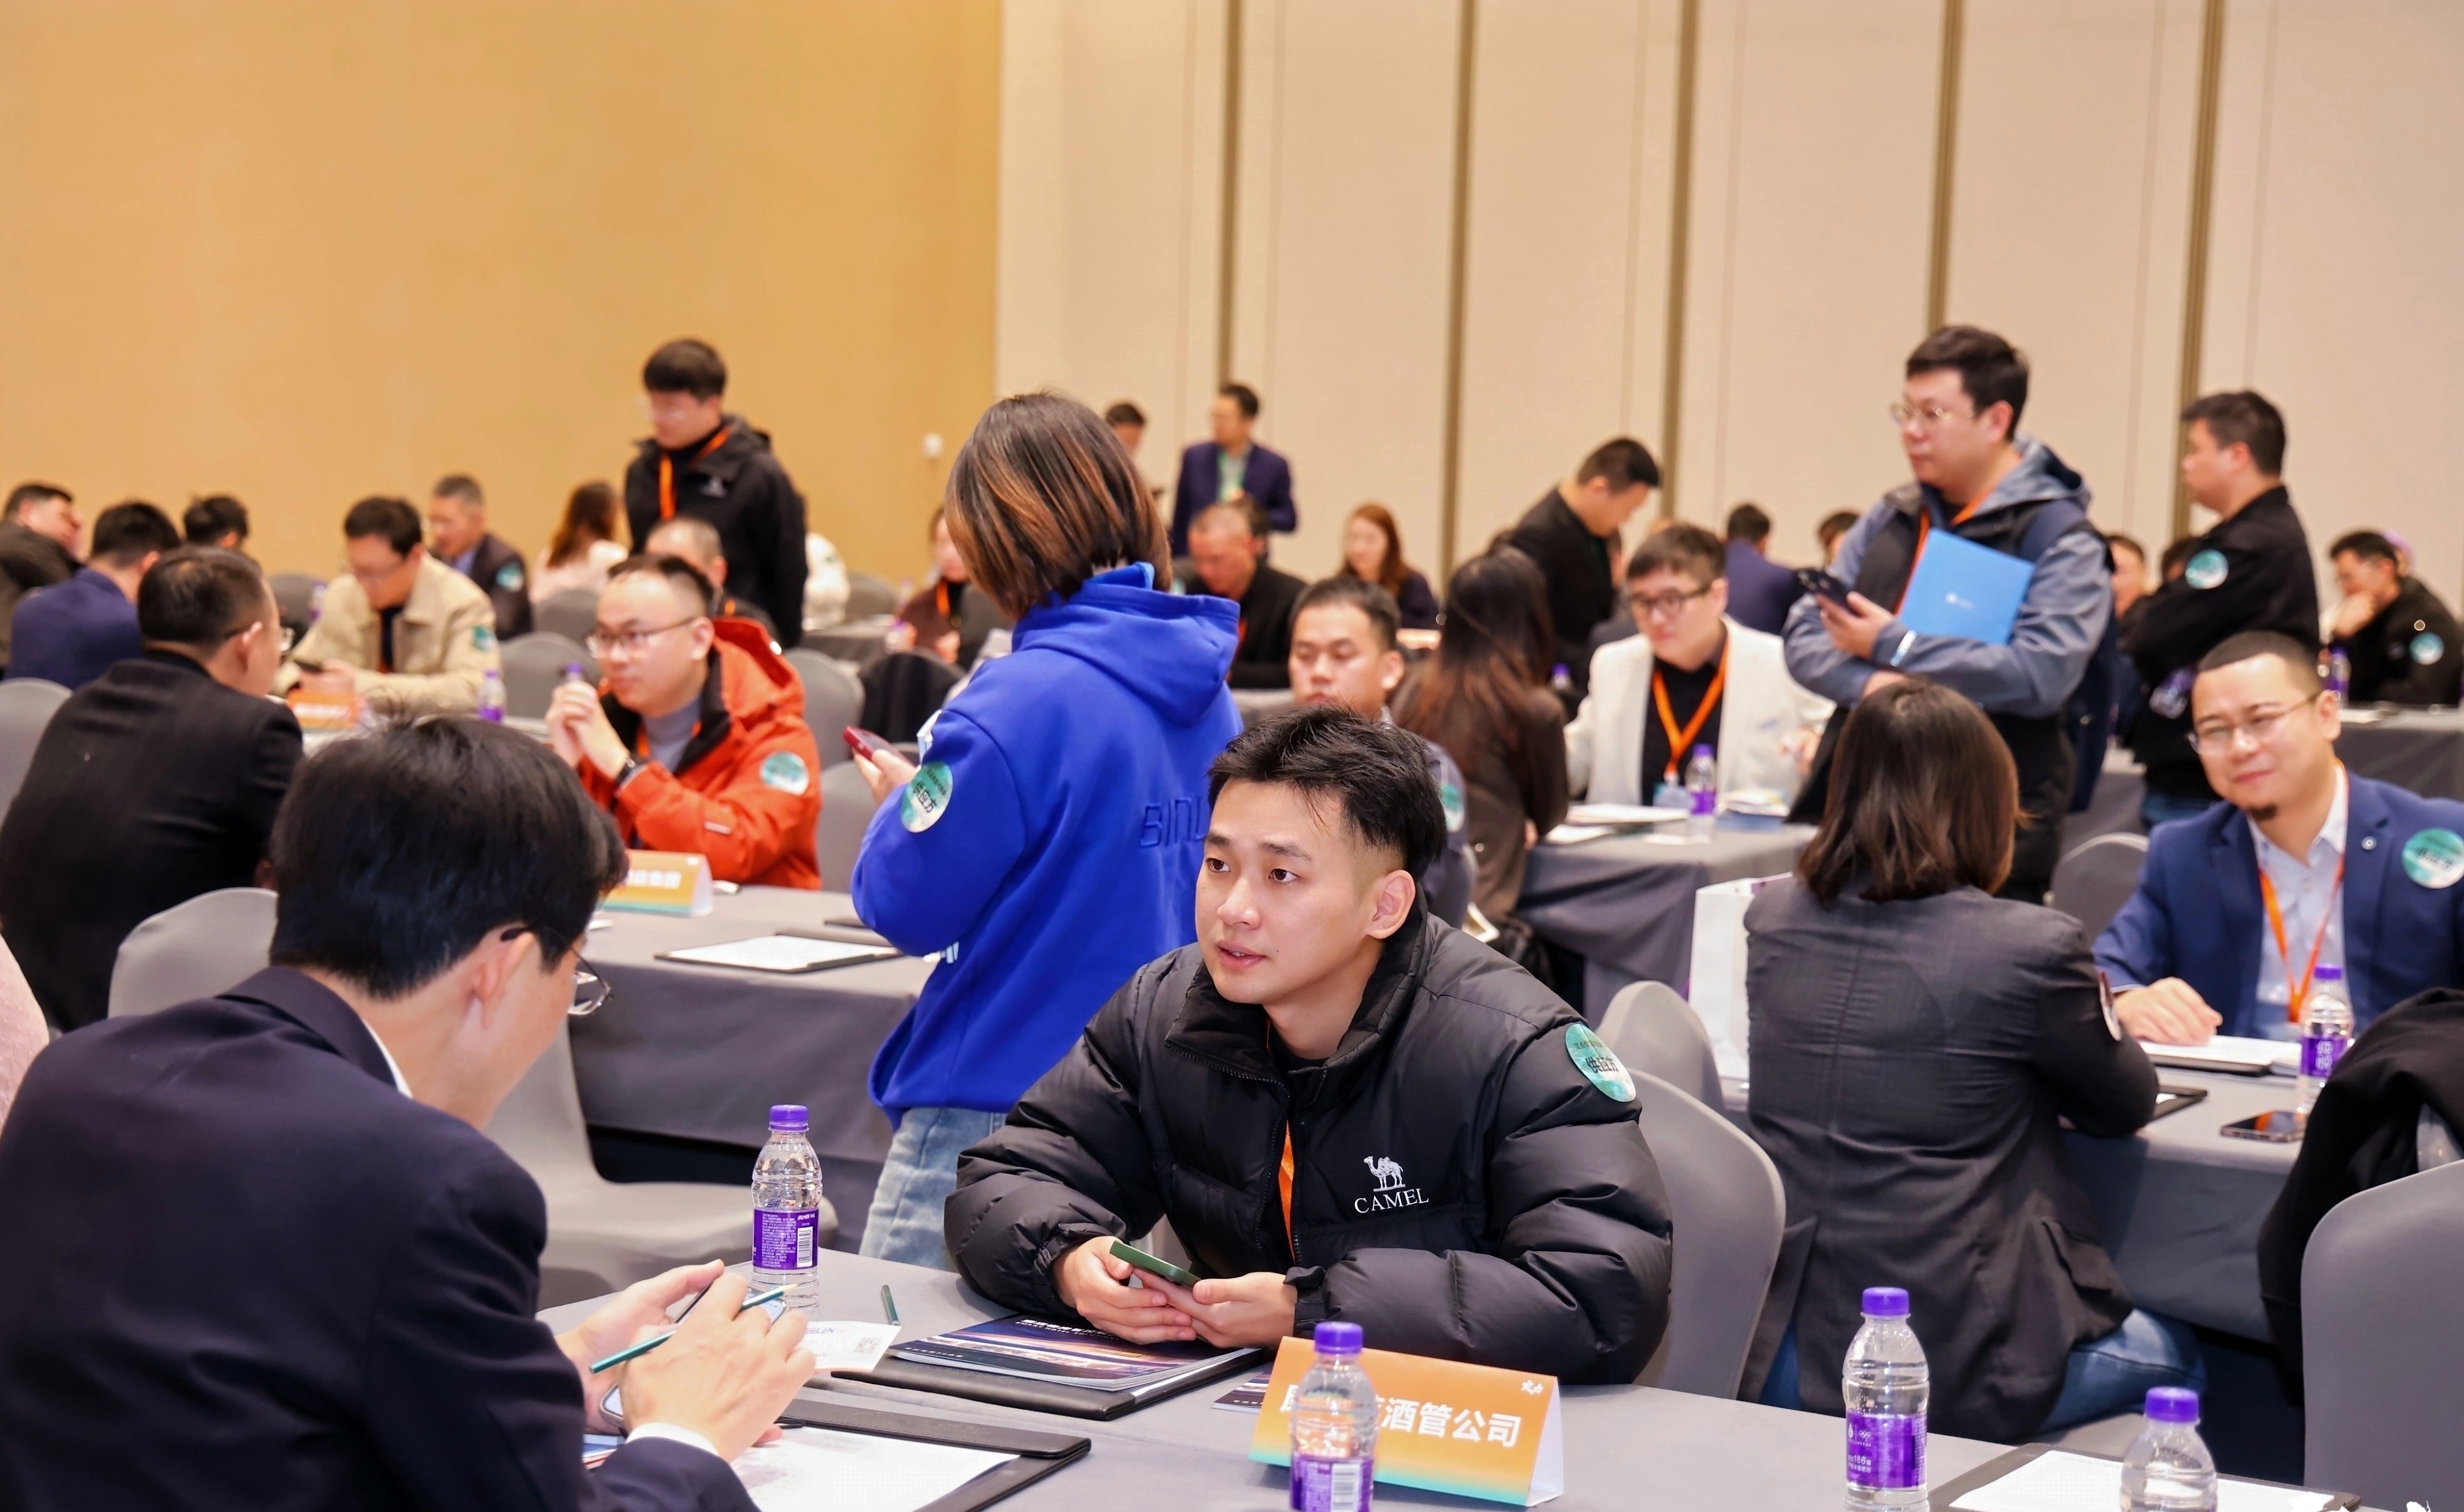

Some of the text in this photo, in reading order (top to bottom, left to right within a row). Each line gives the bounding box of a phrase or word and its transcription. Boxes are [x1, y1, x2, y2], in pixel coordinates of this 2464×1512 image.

[913, 781, 938, 814] 供应方
[1585, 1056, 1618, 1074] 供应方
[1354, 1189, 1429, 1214] CAMEL
[1280, 1384, 1523, 1448] 酒管公司
